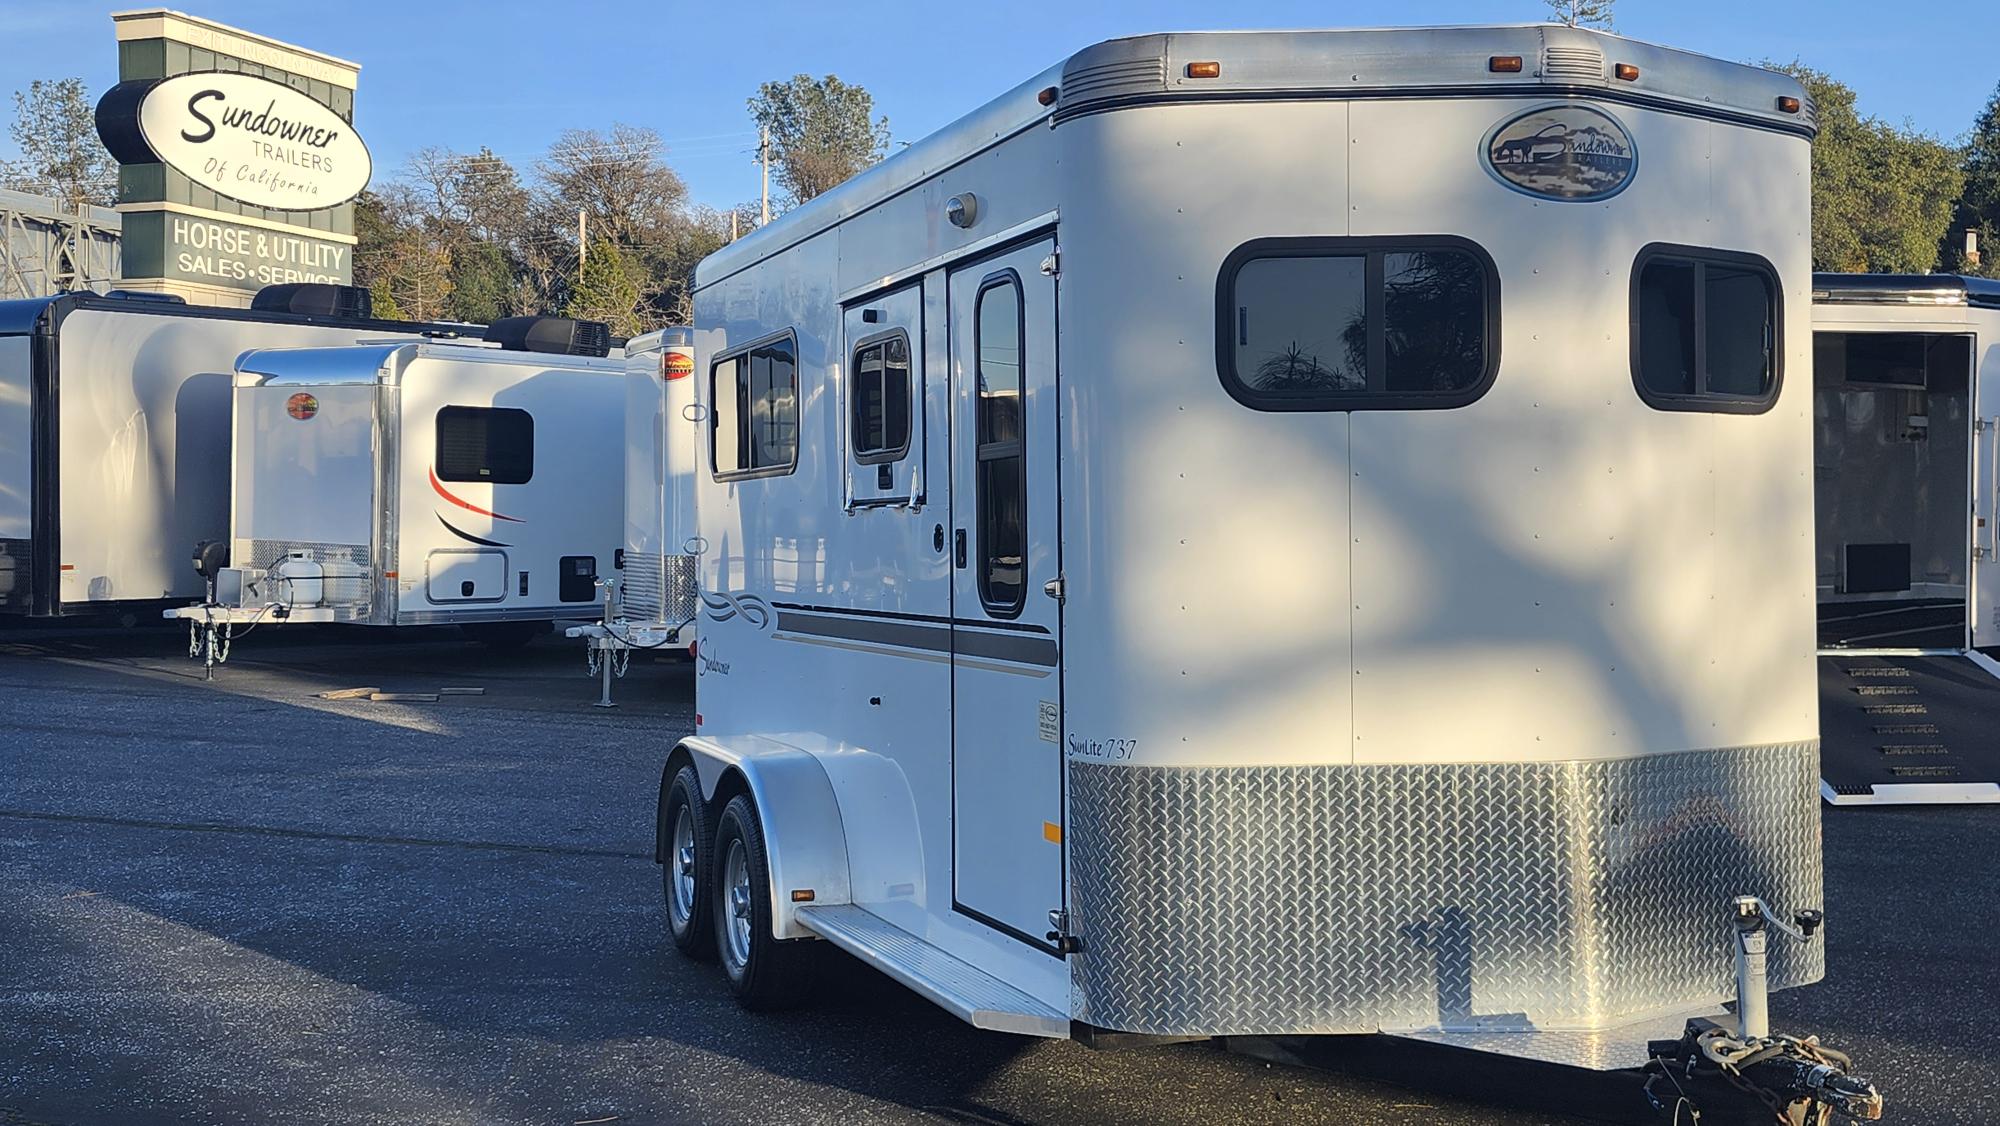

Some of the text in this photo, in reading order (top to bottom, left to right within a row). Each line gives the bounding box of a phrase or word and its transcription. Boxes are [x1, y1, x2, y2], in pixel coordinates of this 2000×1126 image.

[181, 89, 338, 149] Sundowner
[252, 140, 333, 173] TRAILERS
[204, 157, 318, 195] Of California
[174, 218, 344, 270] HORSE & UTILITY
[178, 253, 246, 280] SALES
[1068, 733, 1137, 760] SunLite 737
